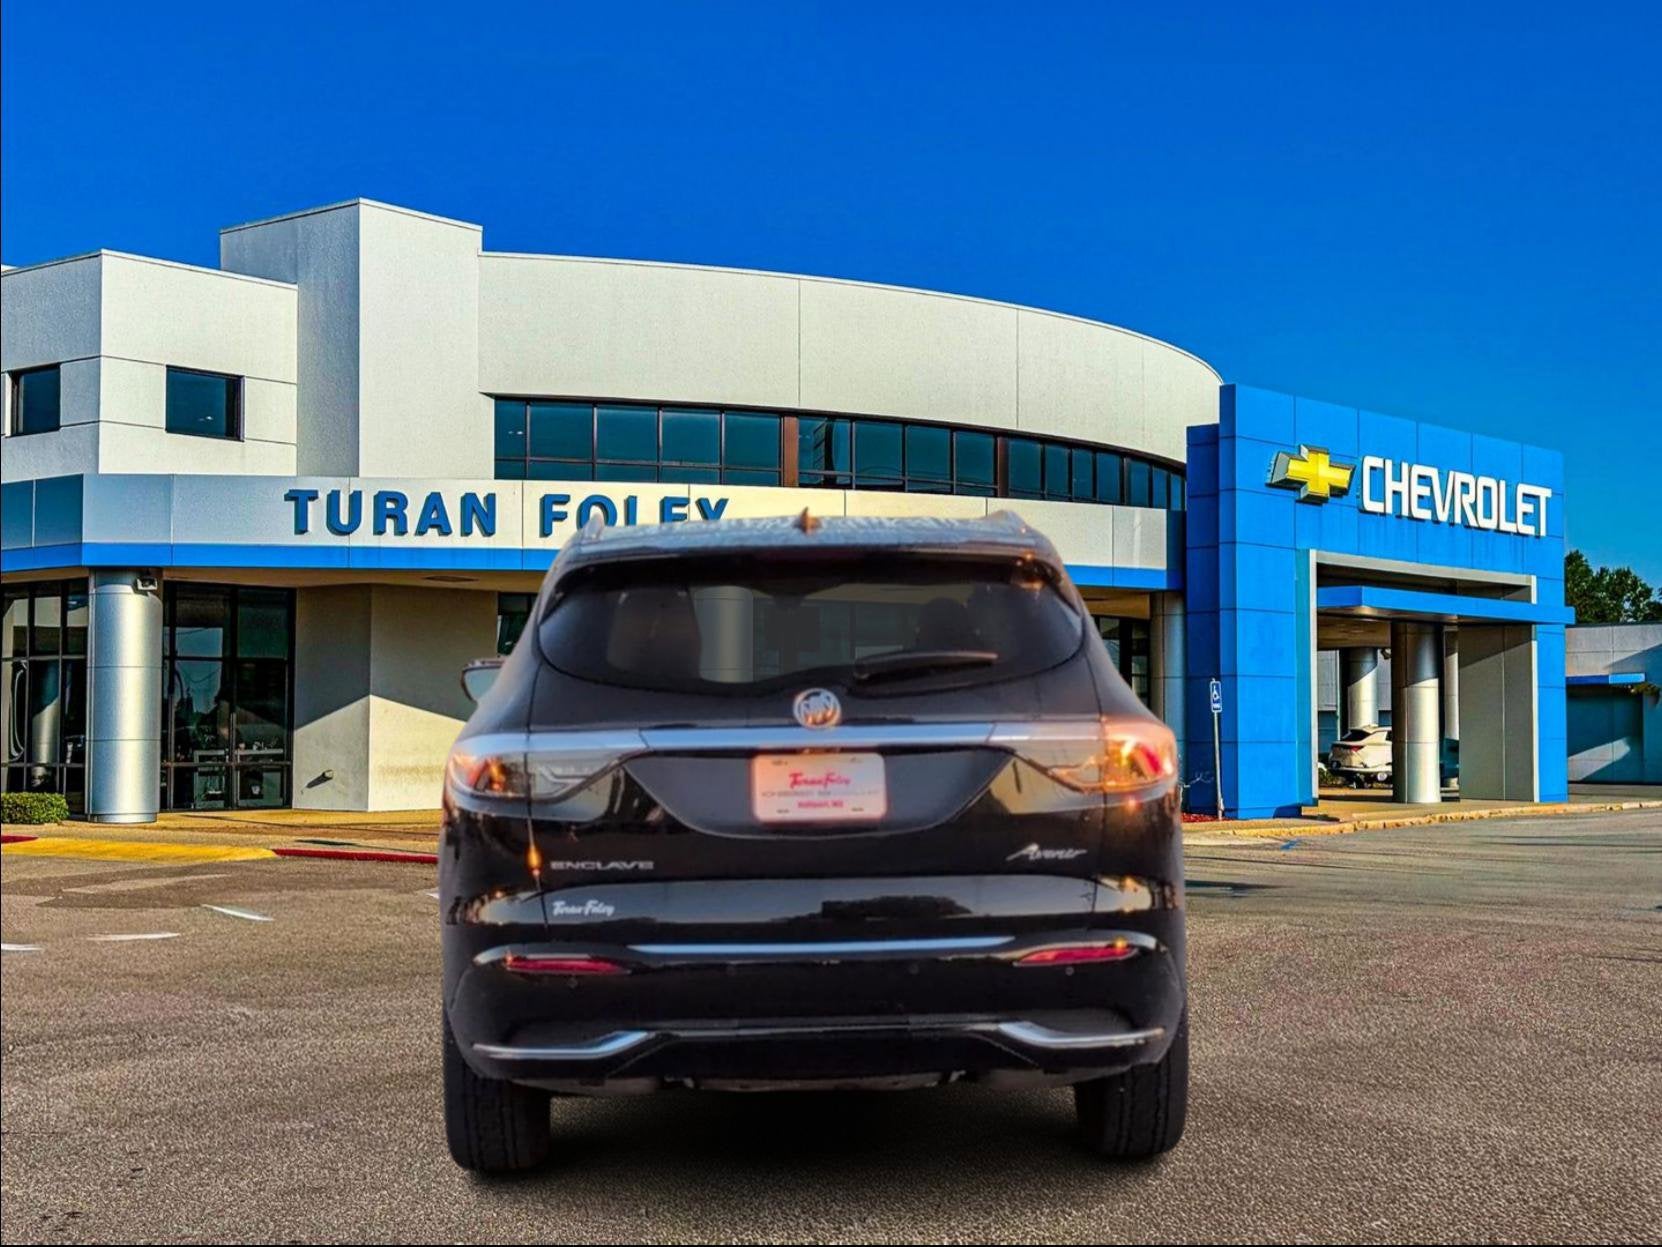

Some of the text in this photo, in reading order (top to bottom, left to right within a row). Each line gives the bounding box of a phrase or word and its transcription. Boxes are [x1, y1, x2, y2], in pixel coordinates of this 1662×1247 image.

[284, 489, 497, 538] TURAN
[1360, 455, 1552, 537] CHEVROLET
[549, 860, 655, 871] ENCLAVE
